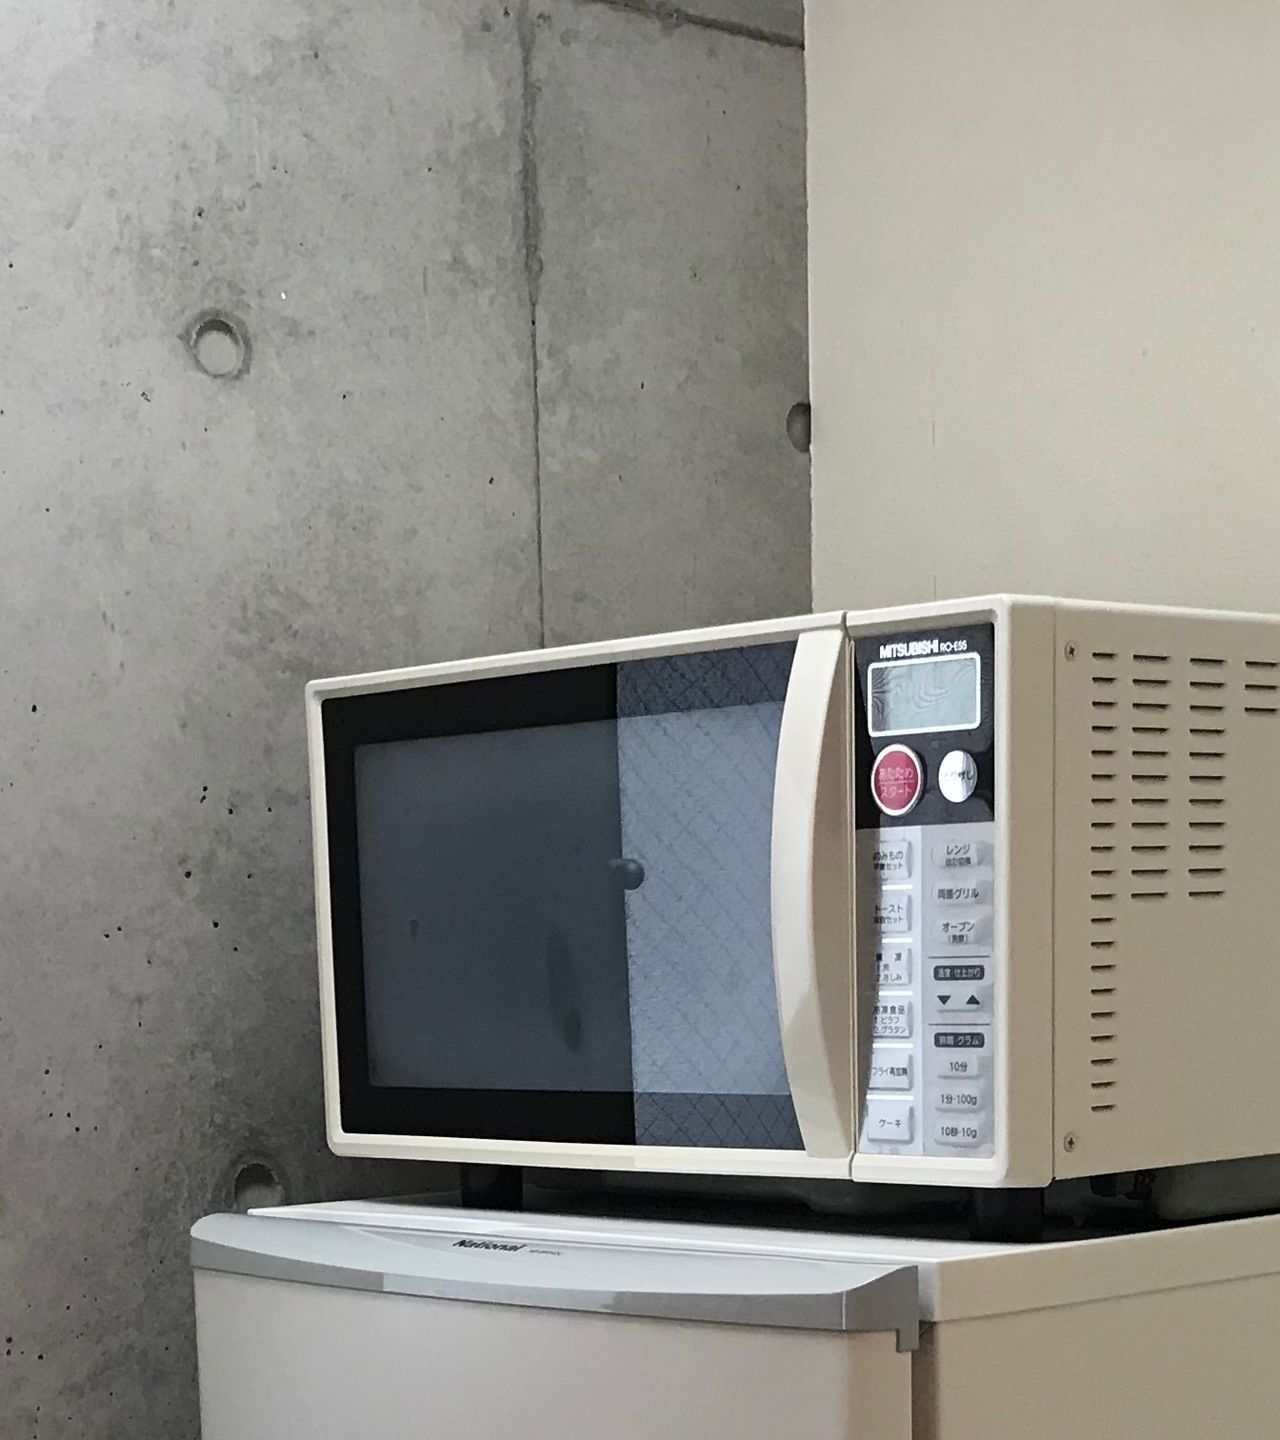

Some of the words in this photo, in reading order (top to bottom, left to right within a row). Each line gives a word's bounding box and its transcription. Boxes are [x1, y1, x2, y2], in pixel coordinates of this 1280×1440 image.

[880, 639, 940, 659] MITSUBISHI
[880, 783, 913, 799] スタート
[946, 843, 971, 856] レンジ
[875, 903, 904, 914] トースト
[942, 921, 975, 933] オーブン
[949, 1061, 968, 1072] 10分
[878, 1118, 903, 1128] ケーキ
[452, 1239, 528, 1252] National
